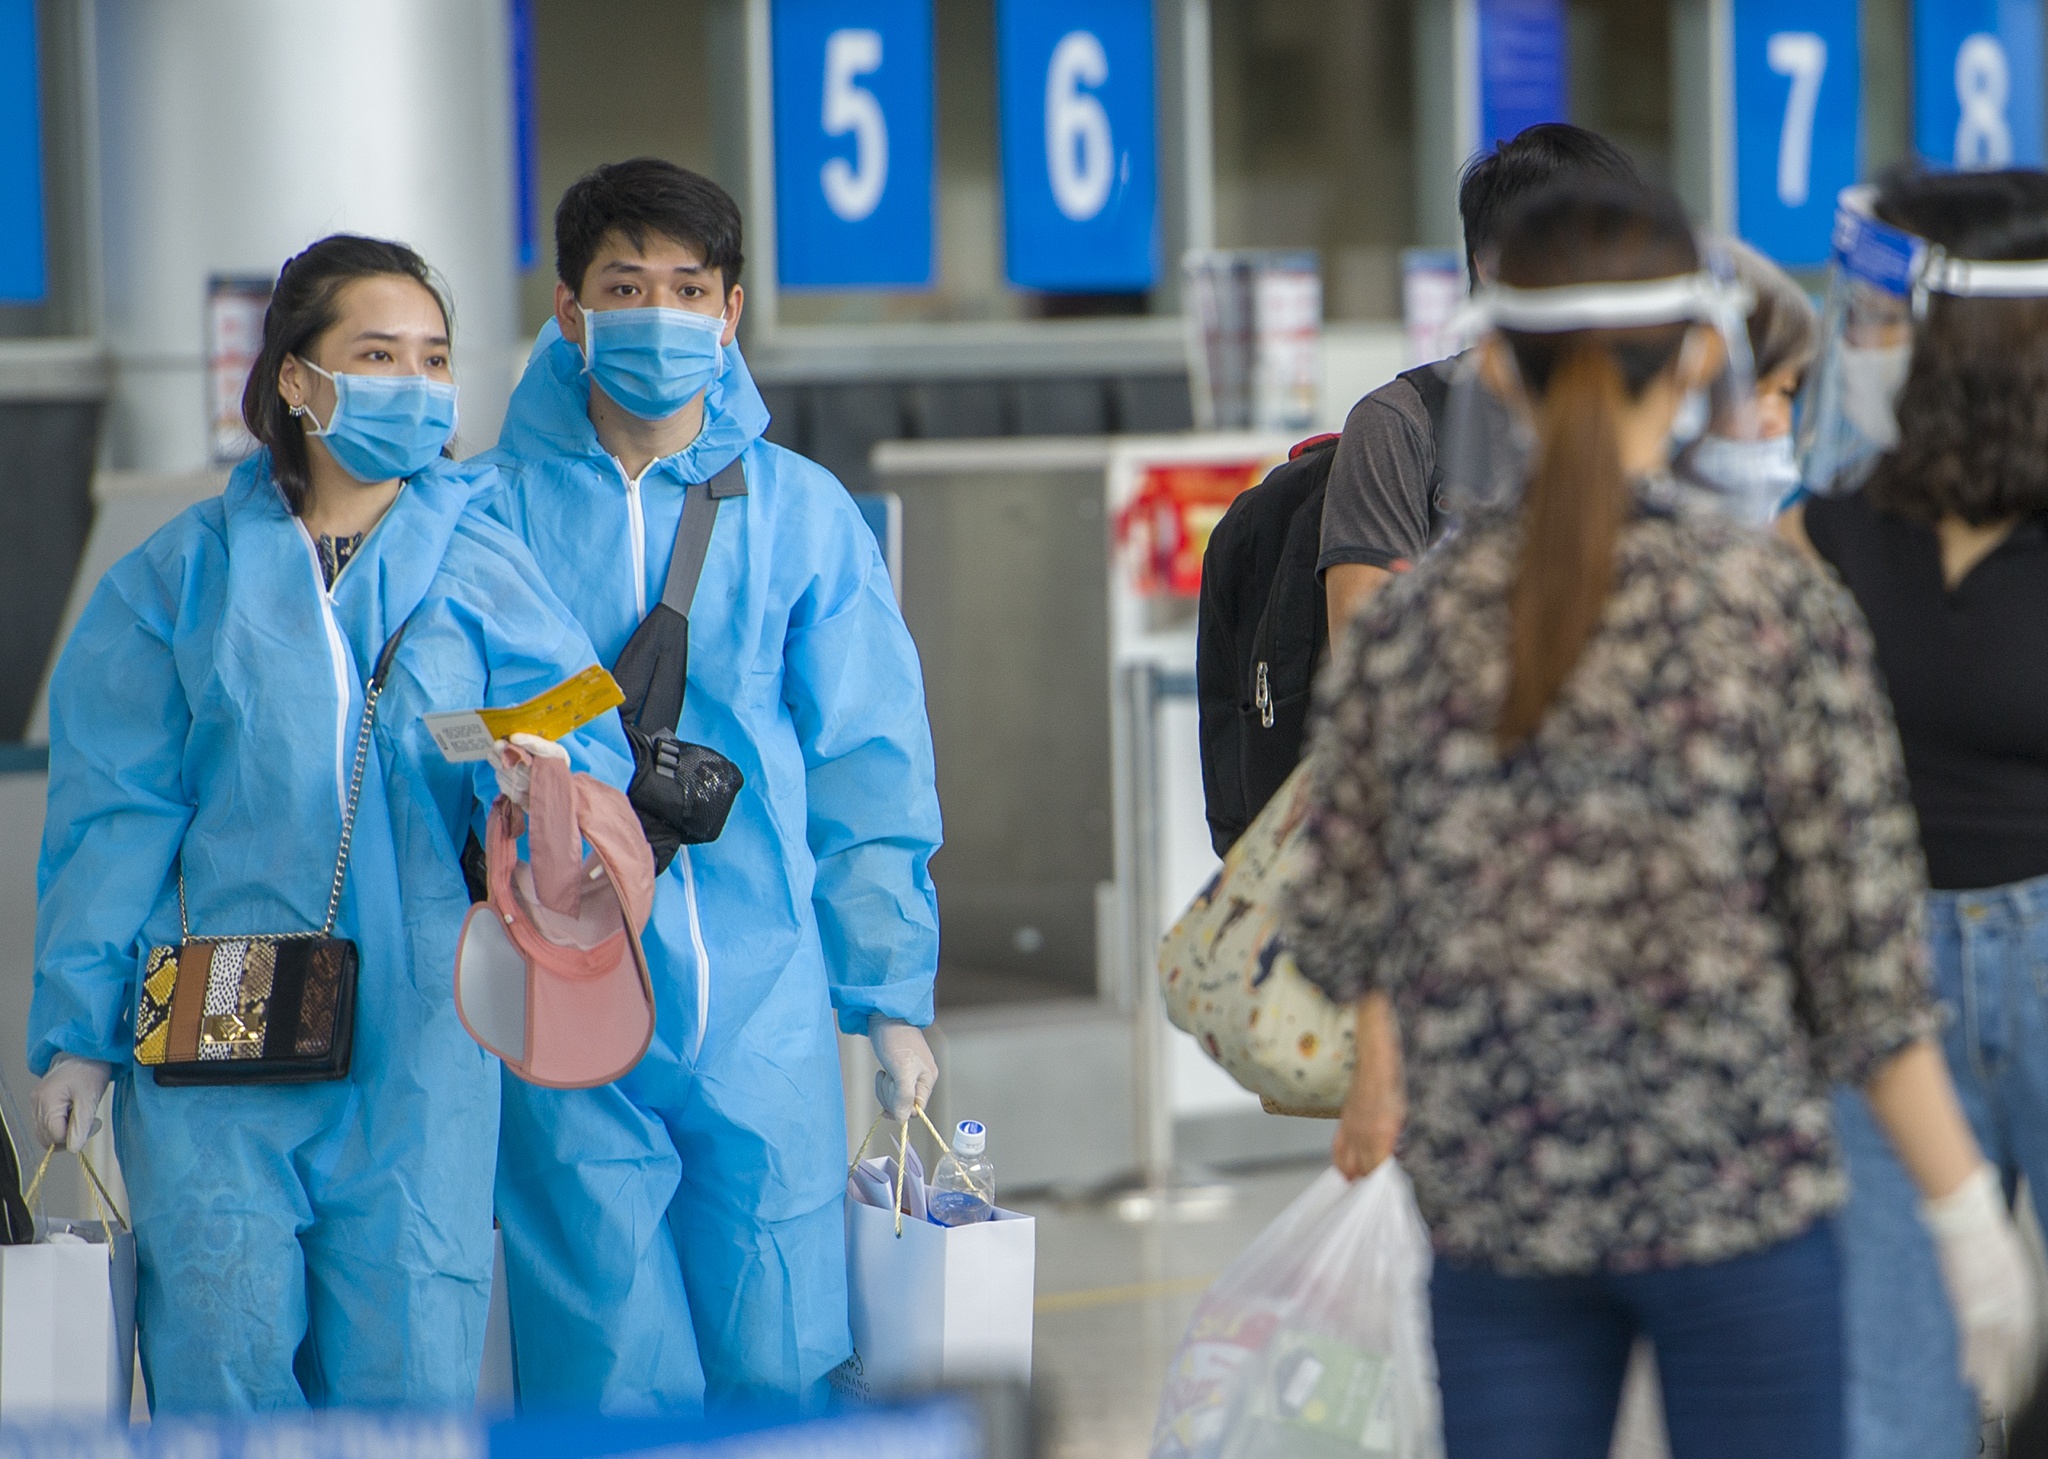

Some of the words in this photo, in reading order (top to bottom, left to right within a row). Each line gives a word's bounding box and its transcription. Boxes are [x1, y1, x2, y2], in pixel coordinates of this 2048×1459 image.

[820, 28, 889, 221] 5
[1044, 30, 1114, 220] 6
[1767, 32, 1827, 207] 7
[1954, 32, 2013, 171] 8
[835, 1369, 870, 1393] DANANG
